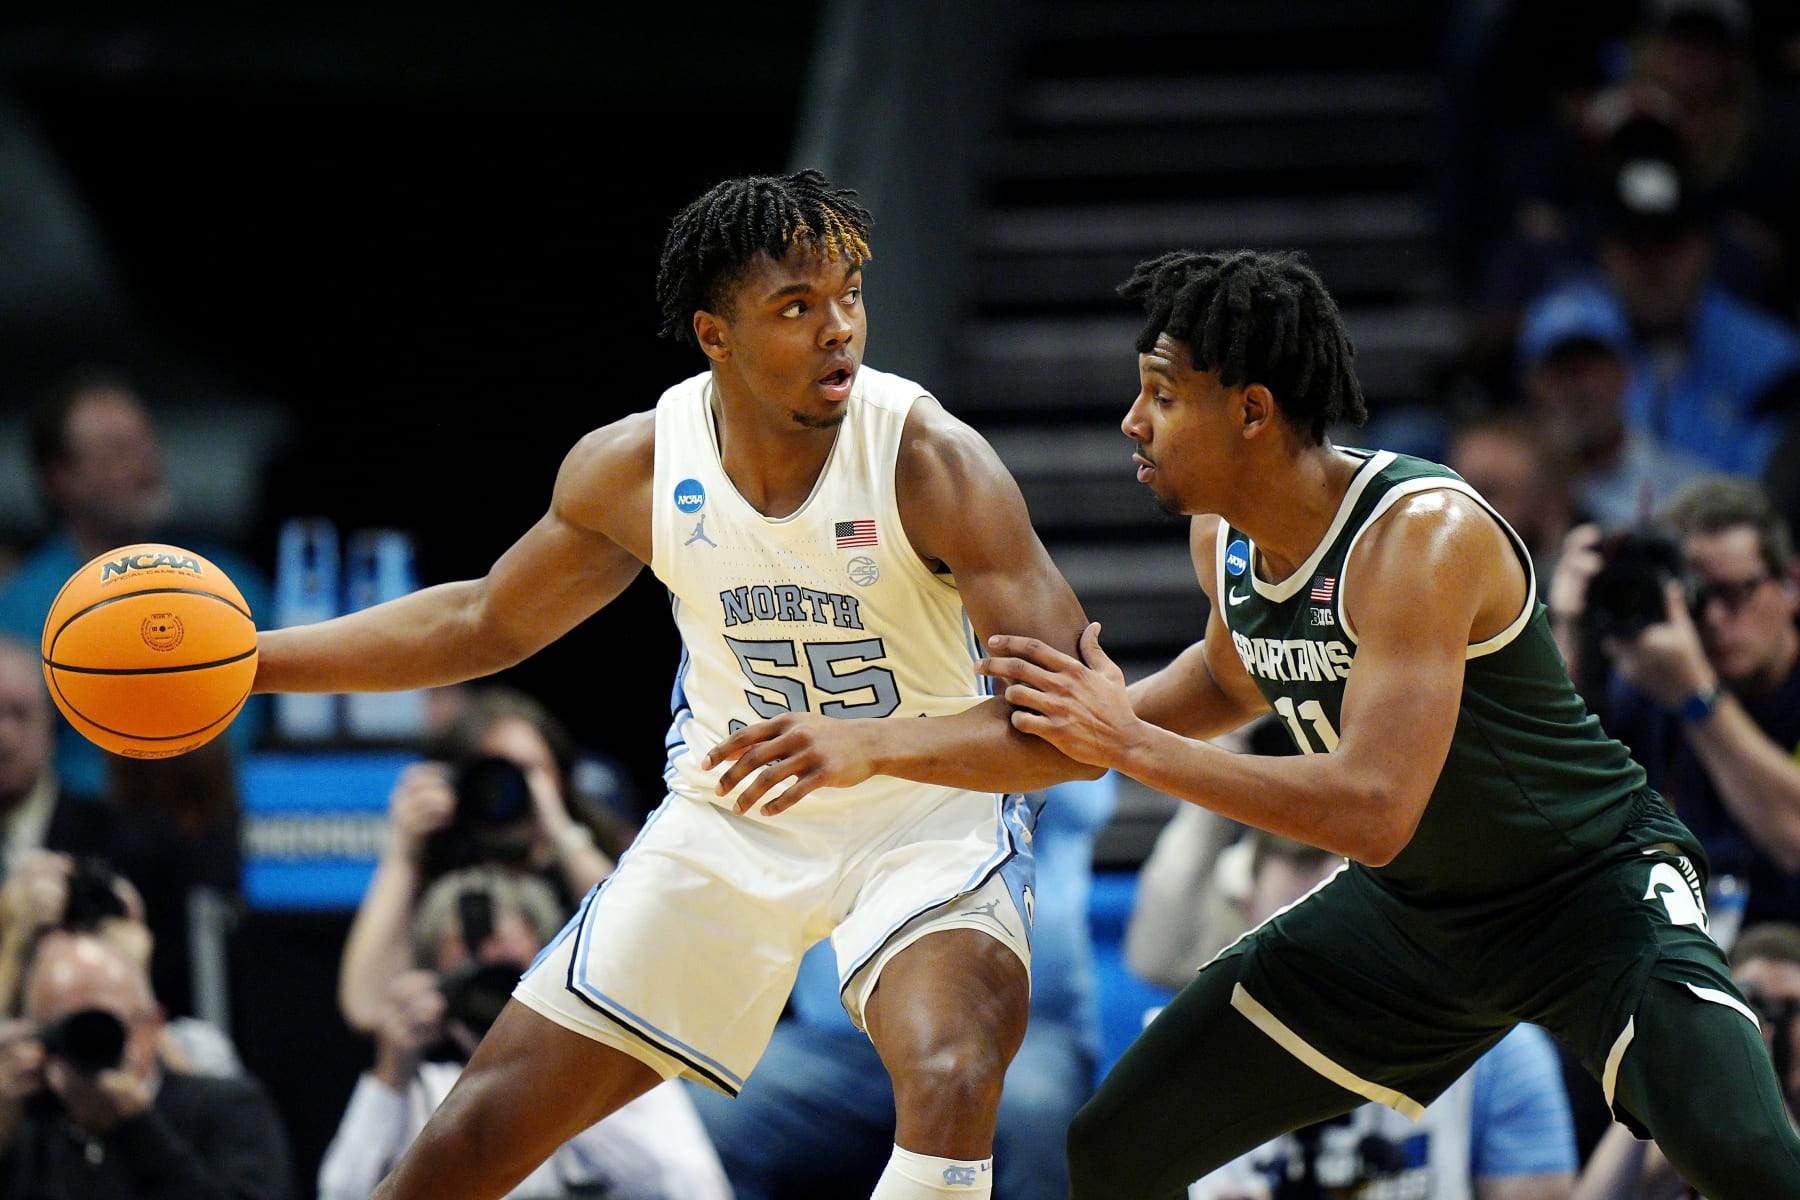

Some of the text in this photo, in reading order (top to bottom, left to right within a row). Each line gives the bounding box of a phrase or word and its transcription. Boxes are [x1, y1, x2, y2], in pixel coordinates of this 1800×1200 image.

[677, 494, 704, 505] NCAA
[101, 552, 203, 584] NCAA
[720, 585, 865, 631] NORTH
[1310, 607, 1335, 626] BIG
[722, 634, 902, 720] 55
[1231, 629, 1355, 685] SPARTANS
[1274, 696, 1342, 755] 11
